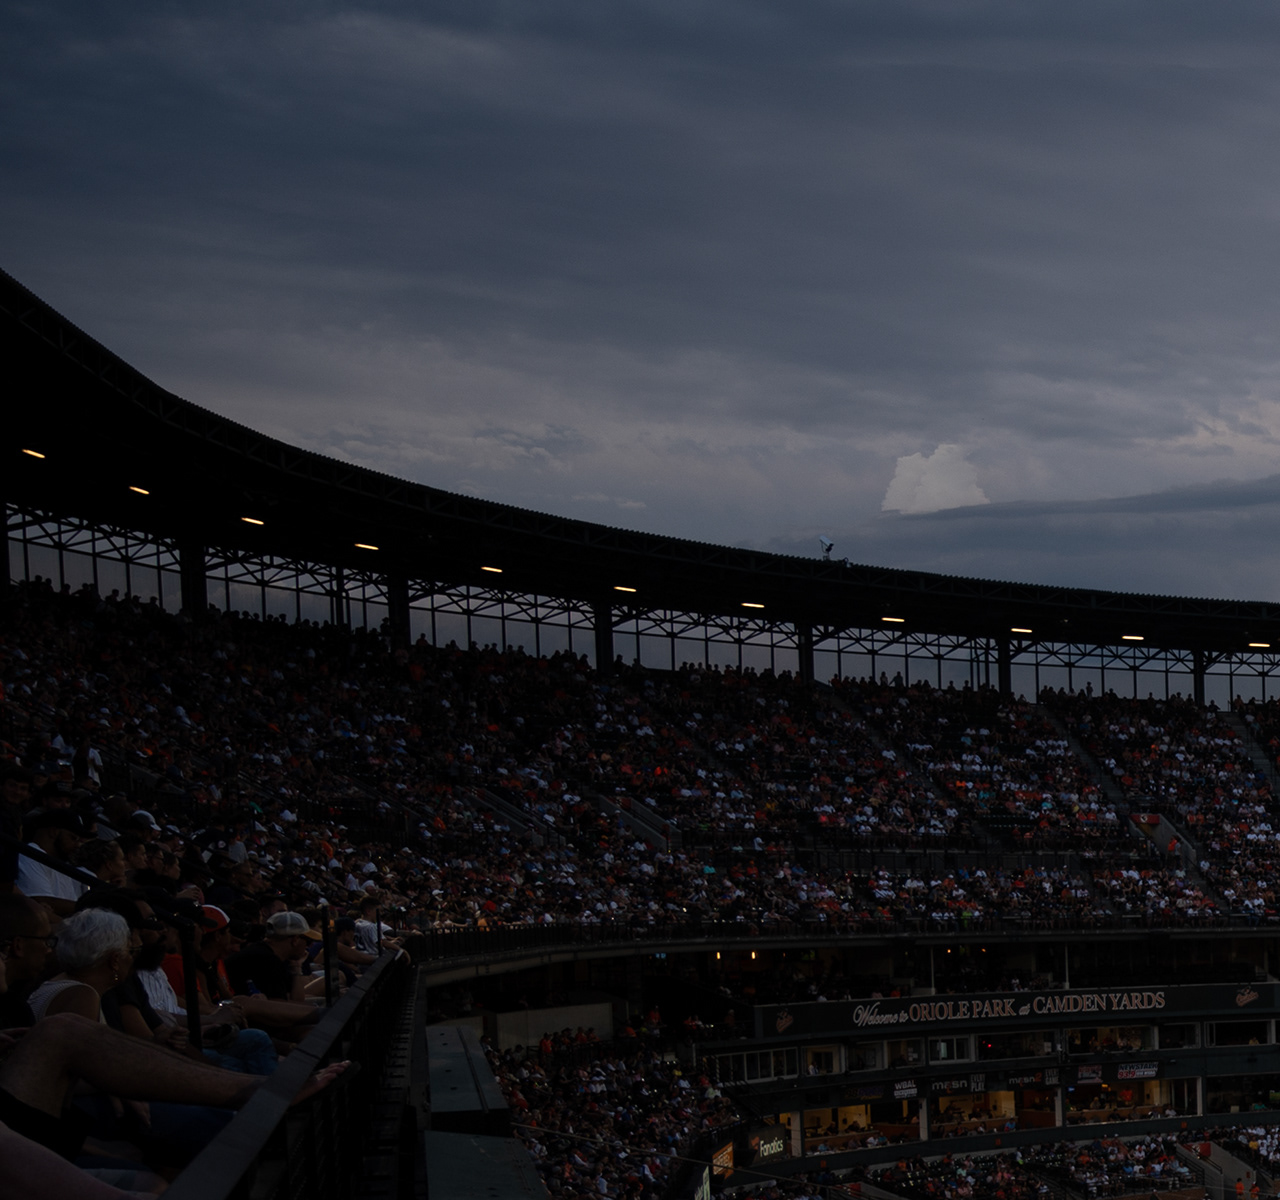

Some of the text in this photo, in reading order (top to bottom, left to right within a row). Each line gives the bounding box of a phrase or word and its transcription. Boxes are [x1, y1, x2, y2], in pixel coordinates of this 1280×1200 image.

[852, 991, 1166, 1026] Welcome to ORIOLE PARK at CAMDEN YARDS
[759, 1136, 784, 1158] Fanatics
